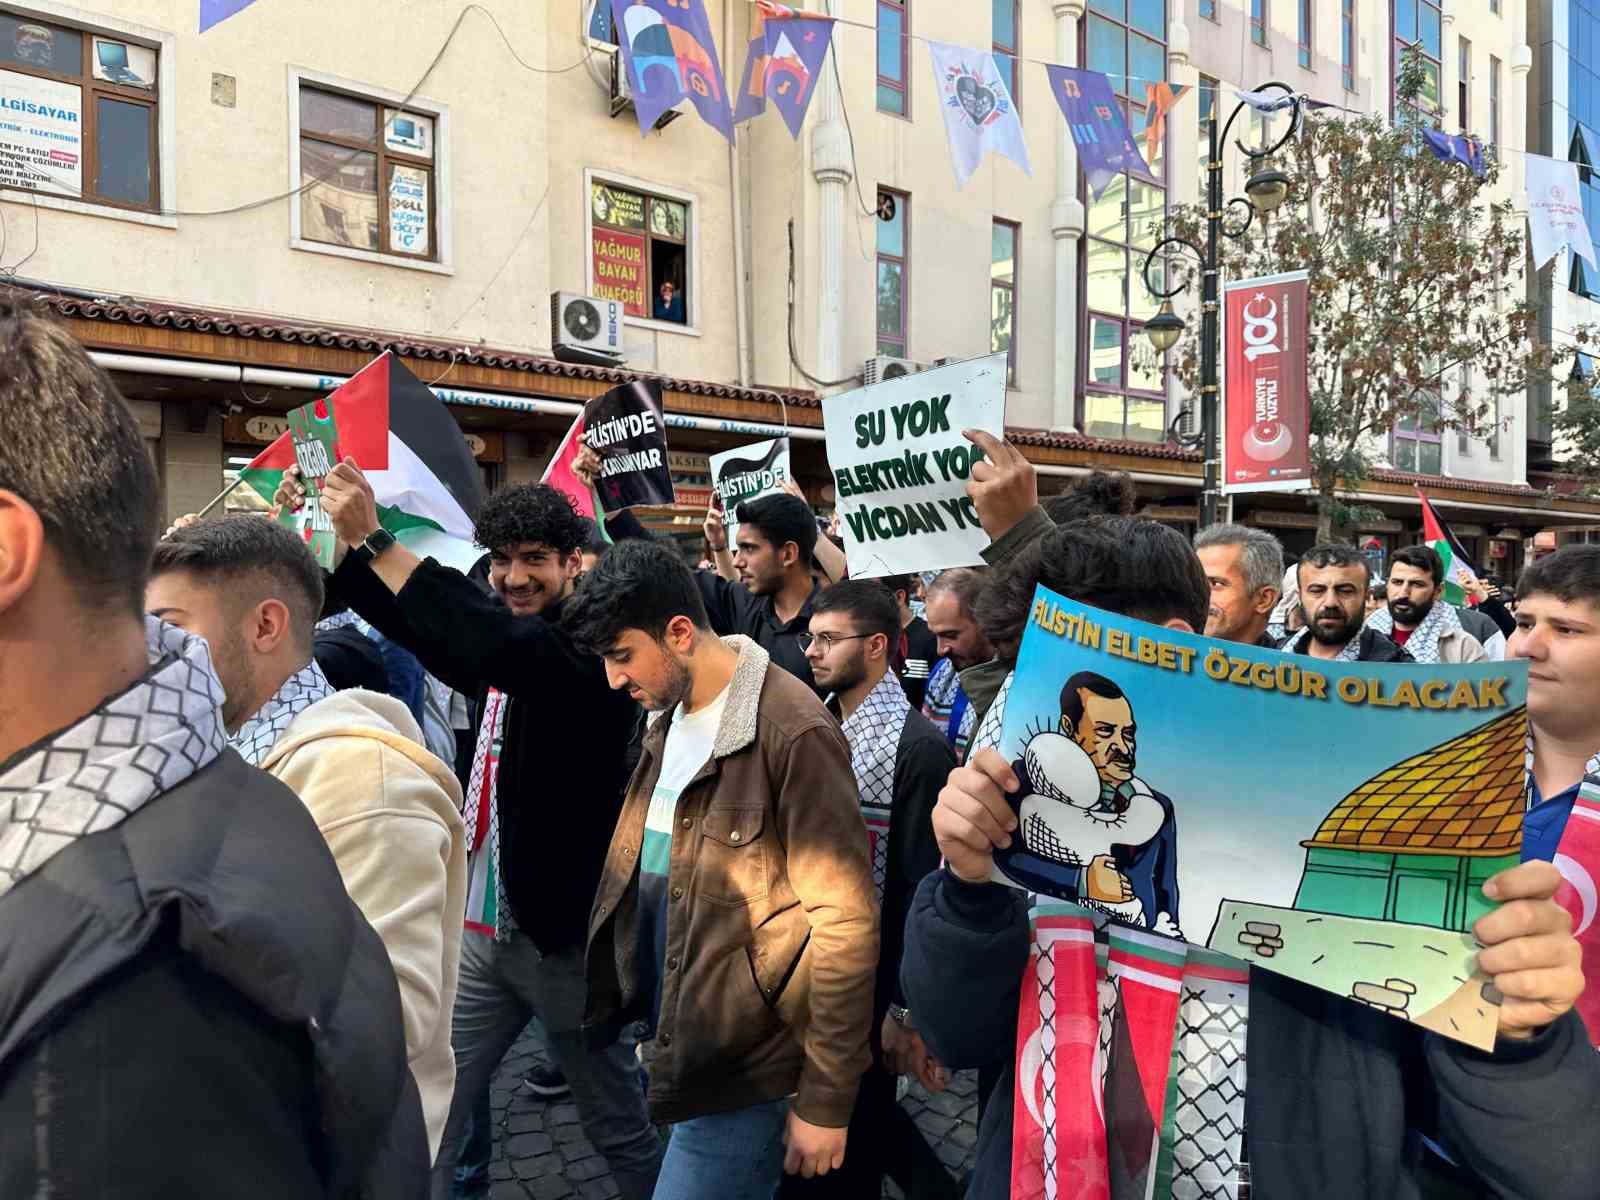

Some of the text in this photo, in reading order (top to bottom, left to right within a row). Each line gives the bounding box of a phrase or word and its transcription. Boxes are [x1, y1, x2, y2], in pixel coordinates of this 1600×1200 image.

[594, 238, 641, 263] YAĞMUR
[599, 262, 636, 282] BAYAN
[608, 302, 617, 347] BEKO
[855, 394, 952, 449] SU YOK
[835, 449, 935, 498] ELEKTRİK
[844, 496, 983, 543] VİCDAN YO
[1033, 597, 1507, 709] FİLİSTİN ELBET ÖZGÜR OLACAK
